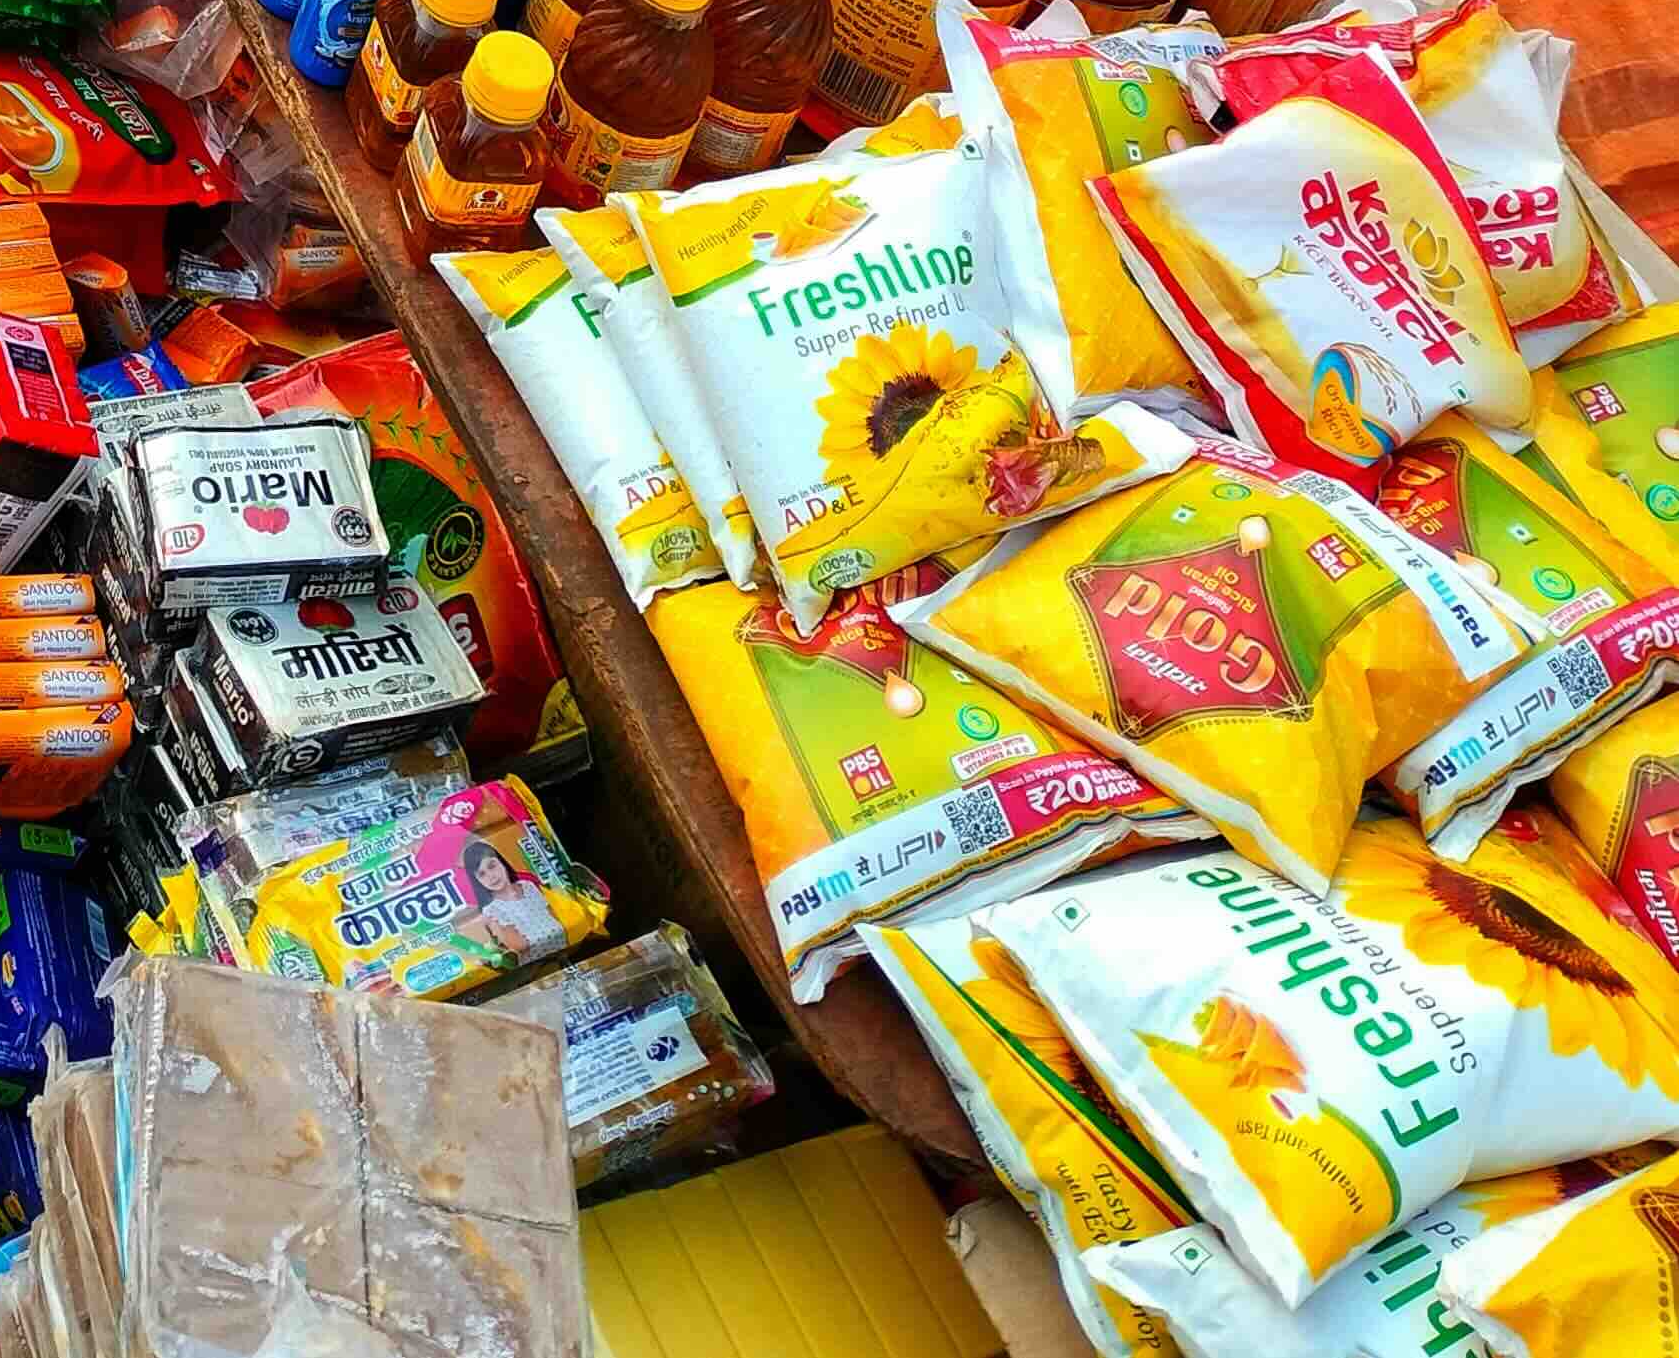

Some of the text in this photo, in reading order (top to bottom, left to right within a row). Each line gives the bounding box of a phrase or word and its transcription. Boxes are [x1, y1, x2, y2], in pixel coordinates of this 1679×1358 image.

[677, 227, 727, 263] Healthy
[747, 241, 974, 339] Freshline
[1328, 269, 1371, 317] BRAN
[1370, 315, 1398, 342] OIL
[794, 293, 952, 359] Super Refined
[1320, 408, 1346, 444] Rich
[1322, 382, 1374, 451] Oryzanol
[255, 459, 303, 470] LAUNDRY
[192, 470, 335, 514] Mario
[815, 552, 857, 575] 100%
[31, 628, 96, 642] SANTOOR
[1102, 572, 1279, 697] Gold
[41, 670, 106, 684] SANTOOR
[213, 654, 255, 726] Mario
[46, 730, 111, 745] SANTOOR
[844, 750, 882, 776] PBS
[1094, 776, 1143, 801] BACK
[334, 871, 467, 947] कान्हा
[1185, 865, 1460, 1151] Freshline
[1400, 979, 1479, 1076] Super
